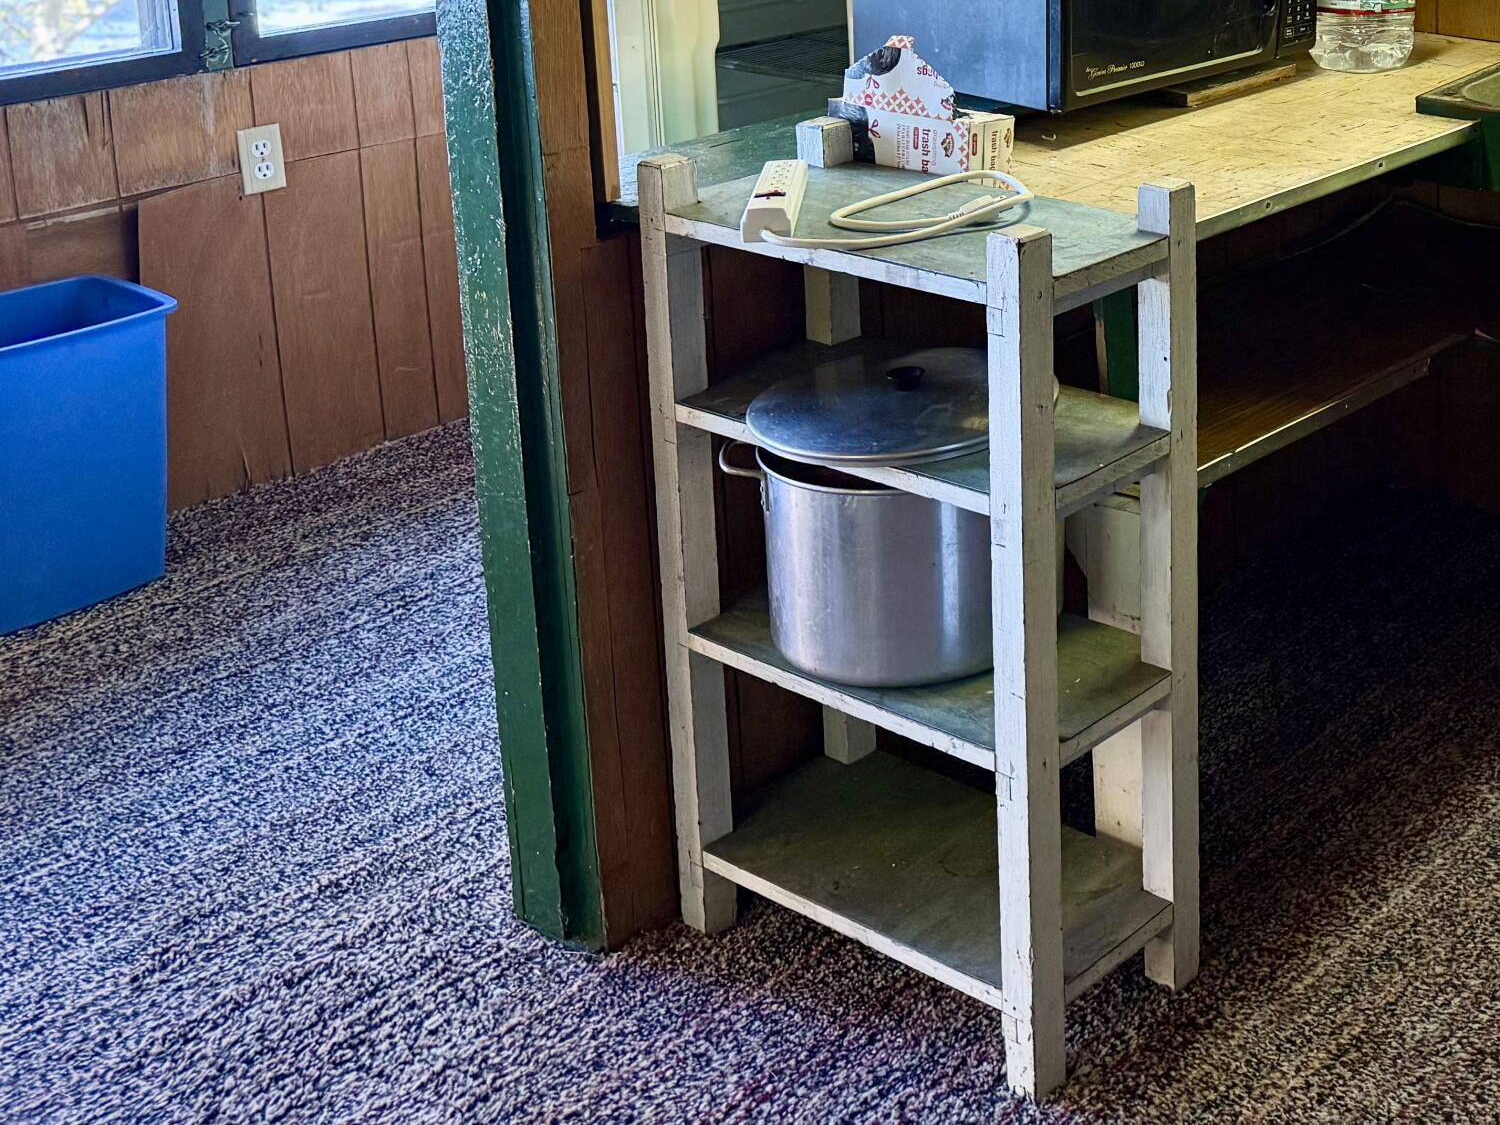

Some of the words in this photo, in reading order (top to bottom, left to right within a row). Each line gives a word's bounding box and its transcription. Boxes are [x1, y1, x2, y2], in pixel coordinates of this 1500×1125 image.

[922, 128, 931, 156] trash
[991, 130, 999, 154] trash
[921, 159, 930, 174] ba
[988, 155, 996, 171] bag
